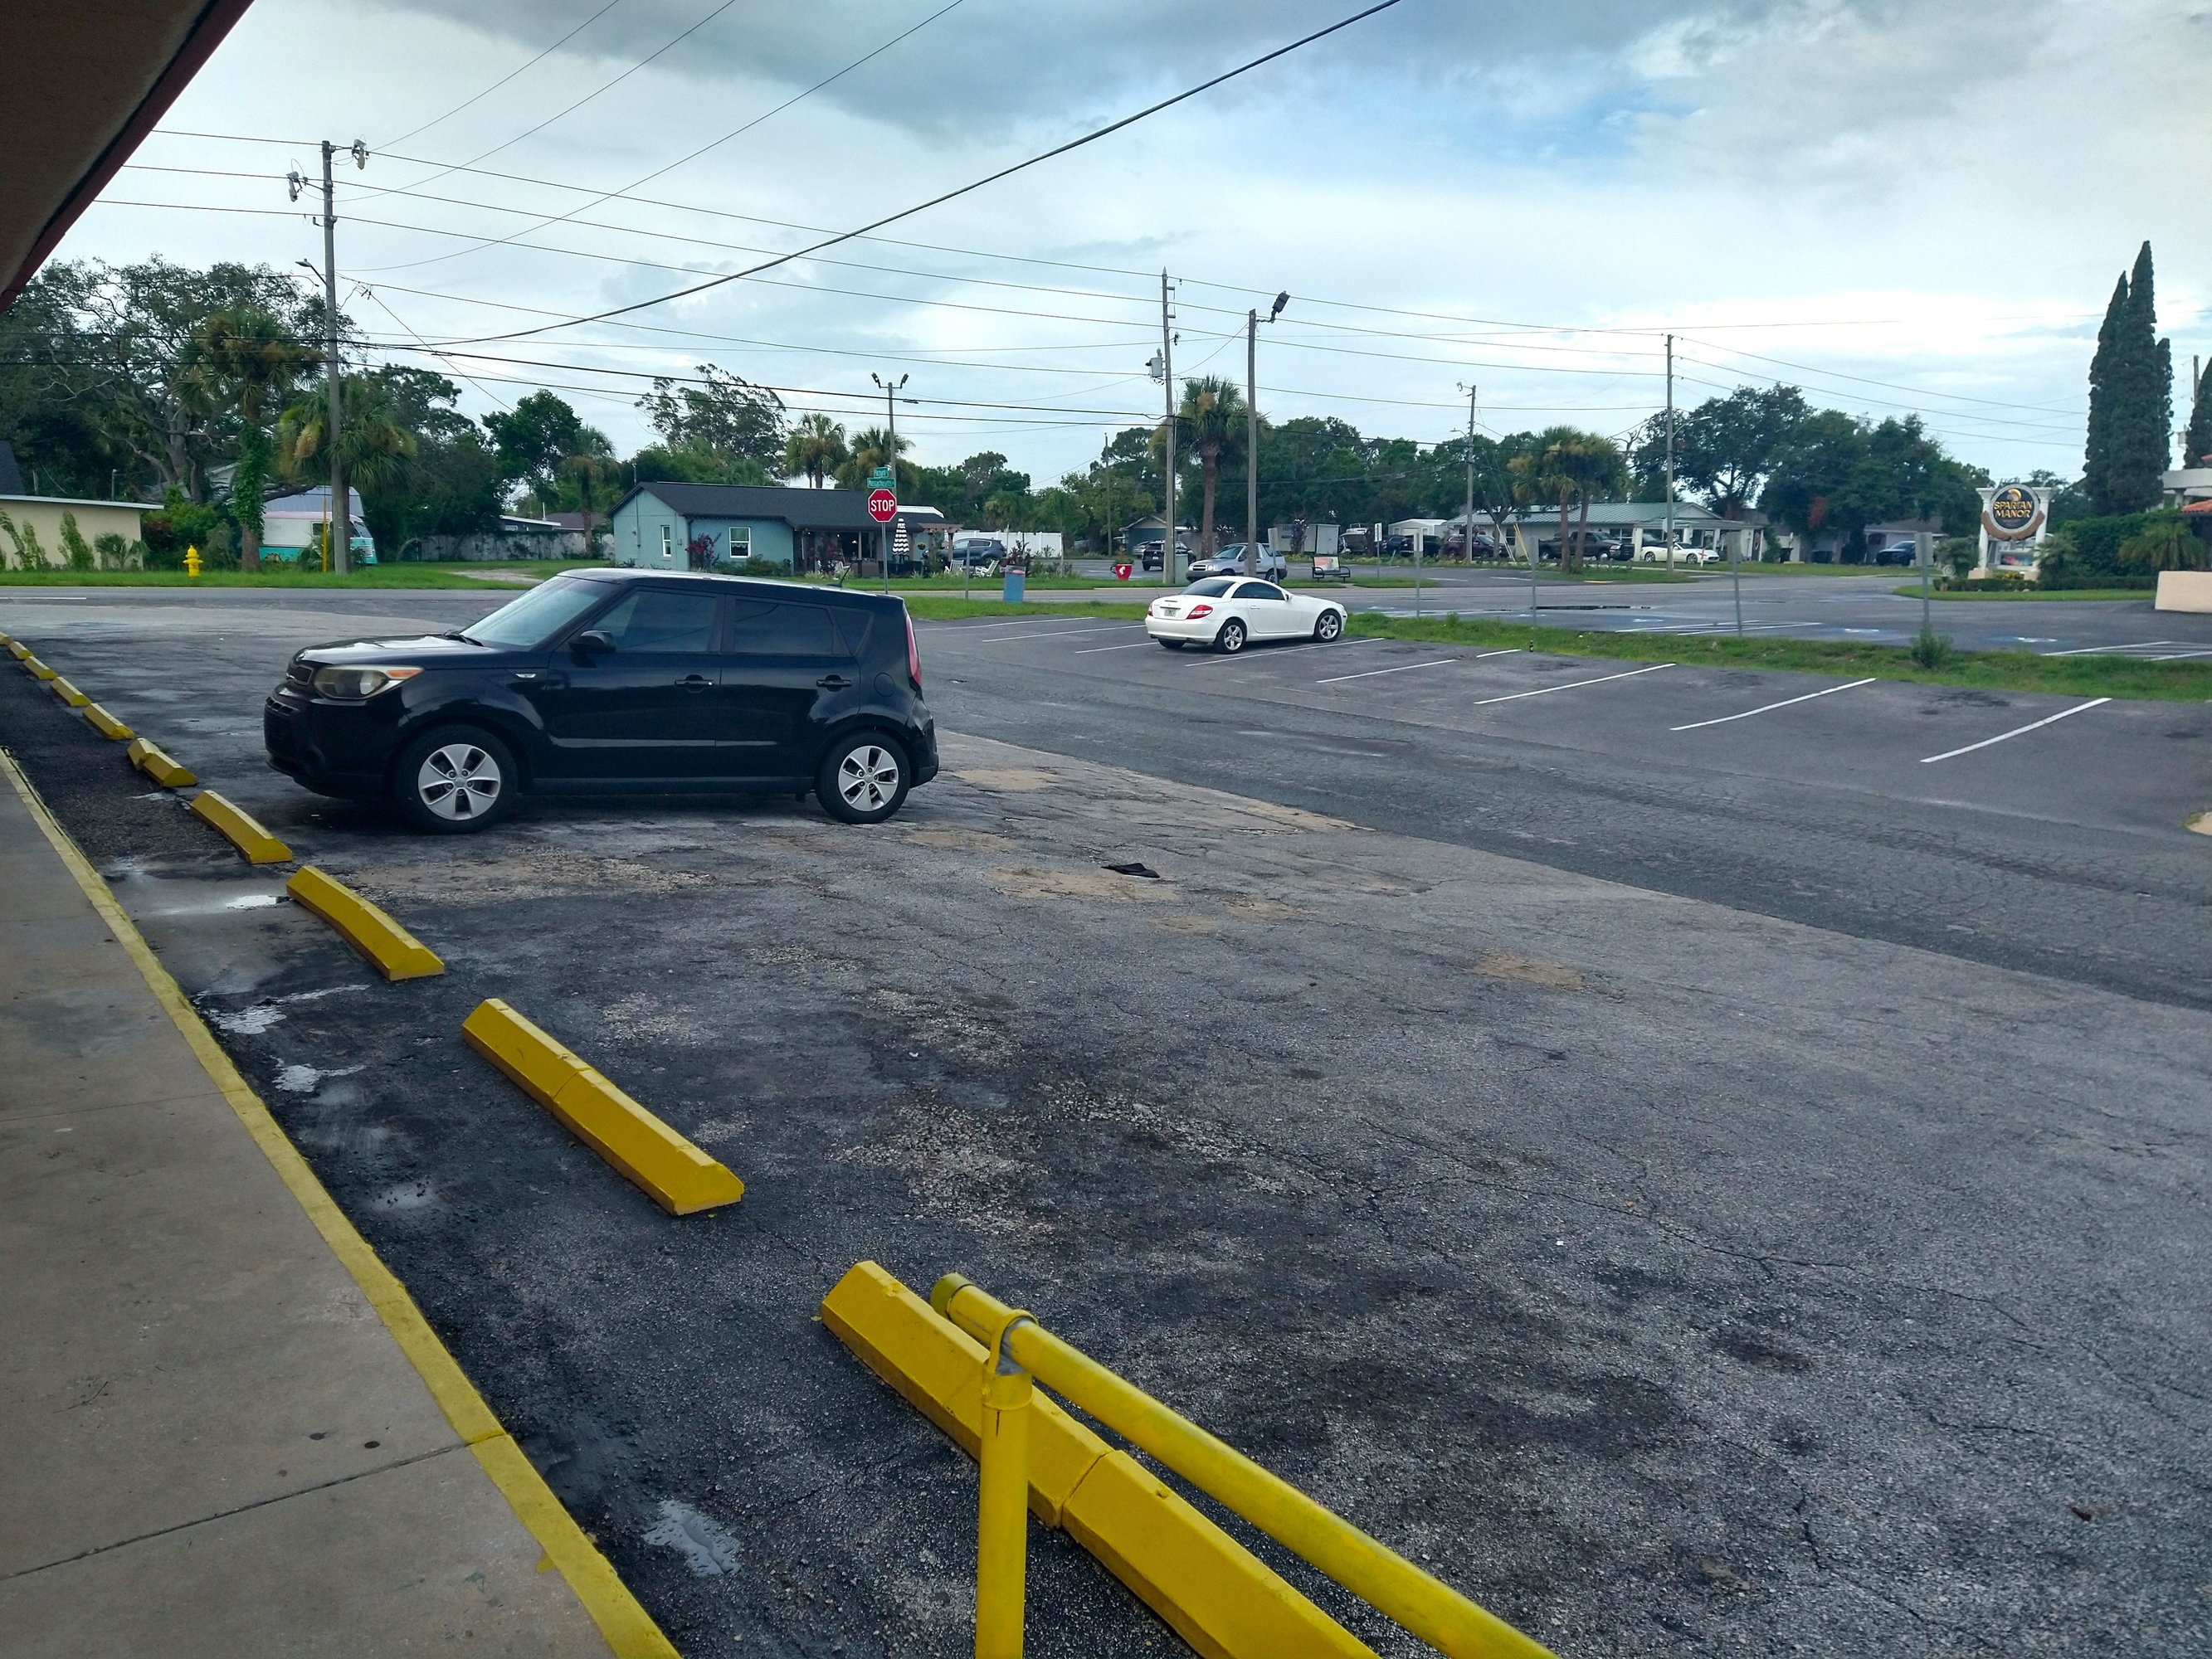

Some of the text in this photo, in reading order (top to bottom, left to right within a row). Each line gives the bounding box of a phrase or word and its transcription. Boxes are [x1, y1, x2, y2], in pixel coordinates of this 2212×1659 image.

[870, 499, 894, 512] STOP
[1994, 501, 2033, 510] SPARTAN
[1995, 509, 2031, 518] MANOR
